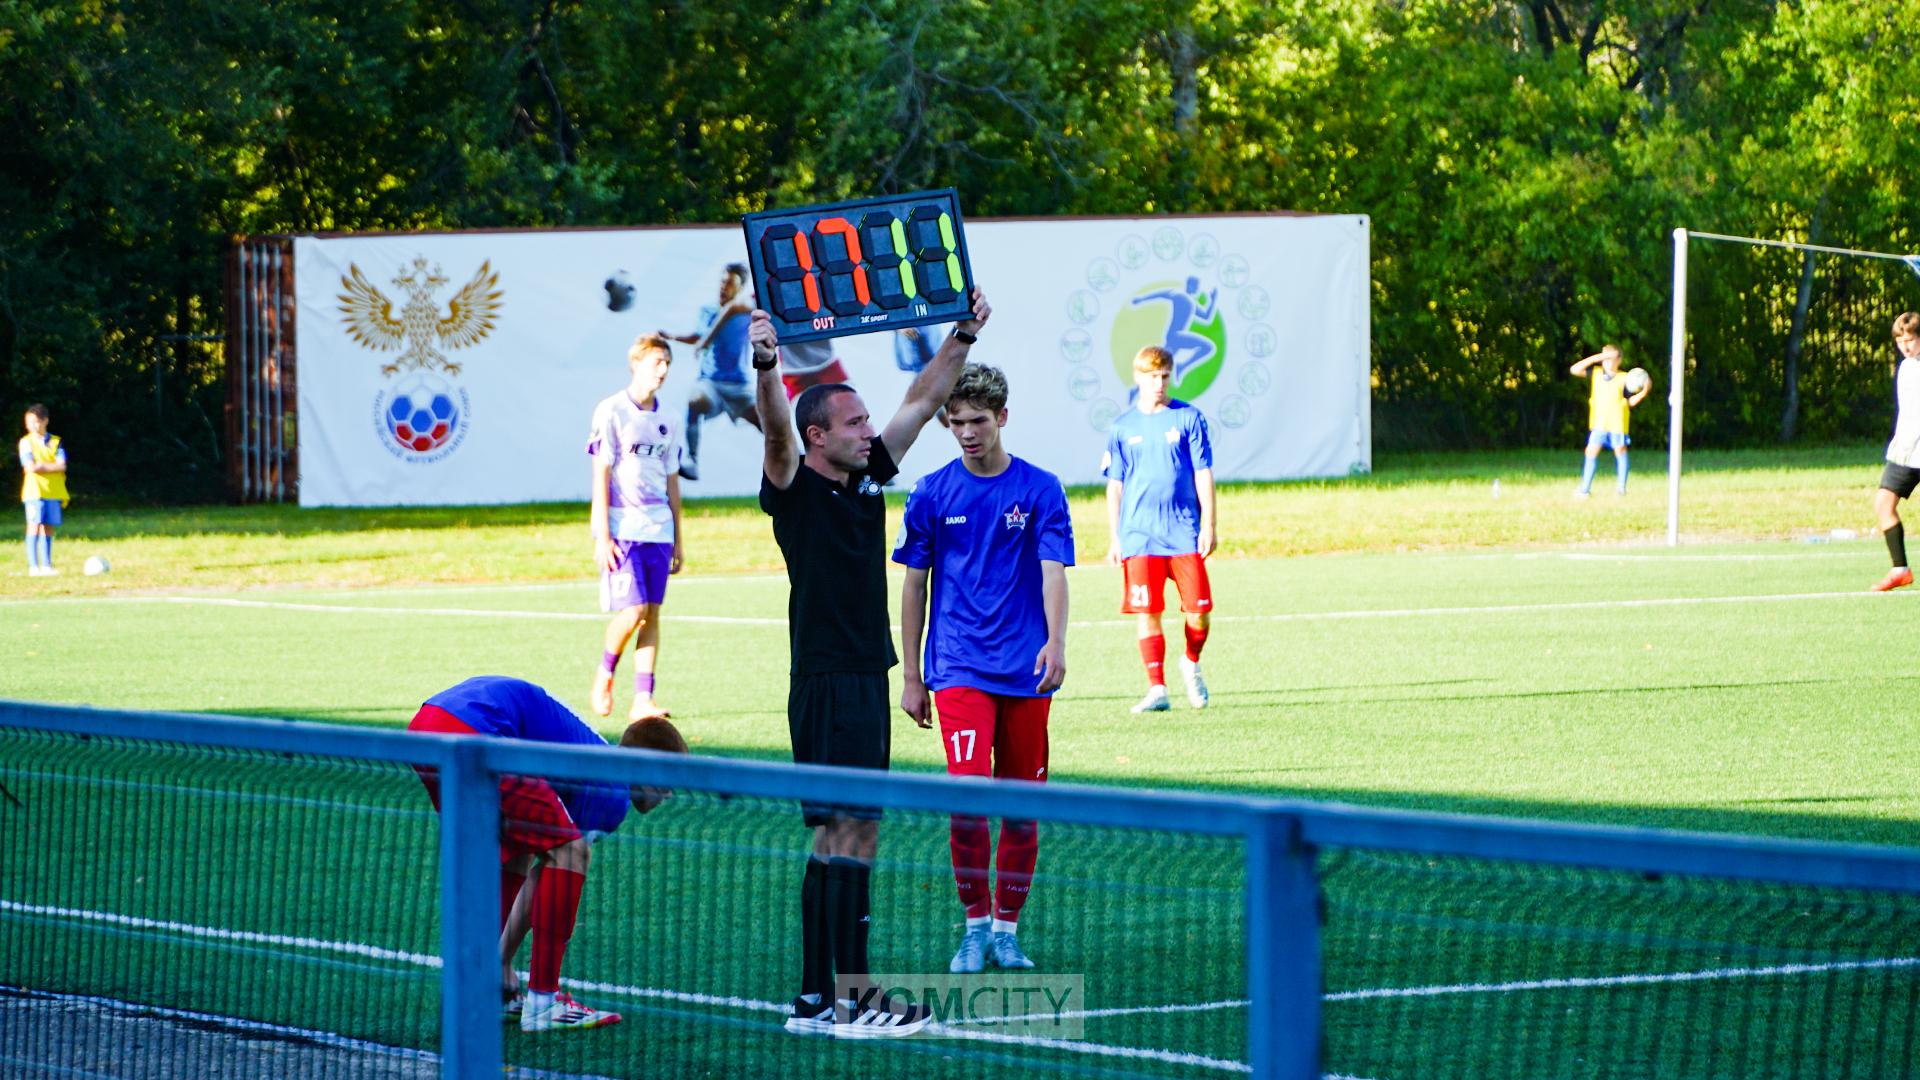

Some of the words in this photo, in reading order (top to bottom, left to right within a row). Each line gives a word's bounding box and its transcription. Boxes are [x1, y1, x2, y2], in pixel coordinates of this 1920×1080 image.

[915, 303, 928, 317] IN
[813, 316, 835, 330] OUT
[945, 515, 967, 525] JAKO
[1131, 585, 1149, 607] 21
[951, 729, 976, 763] 17
